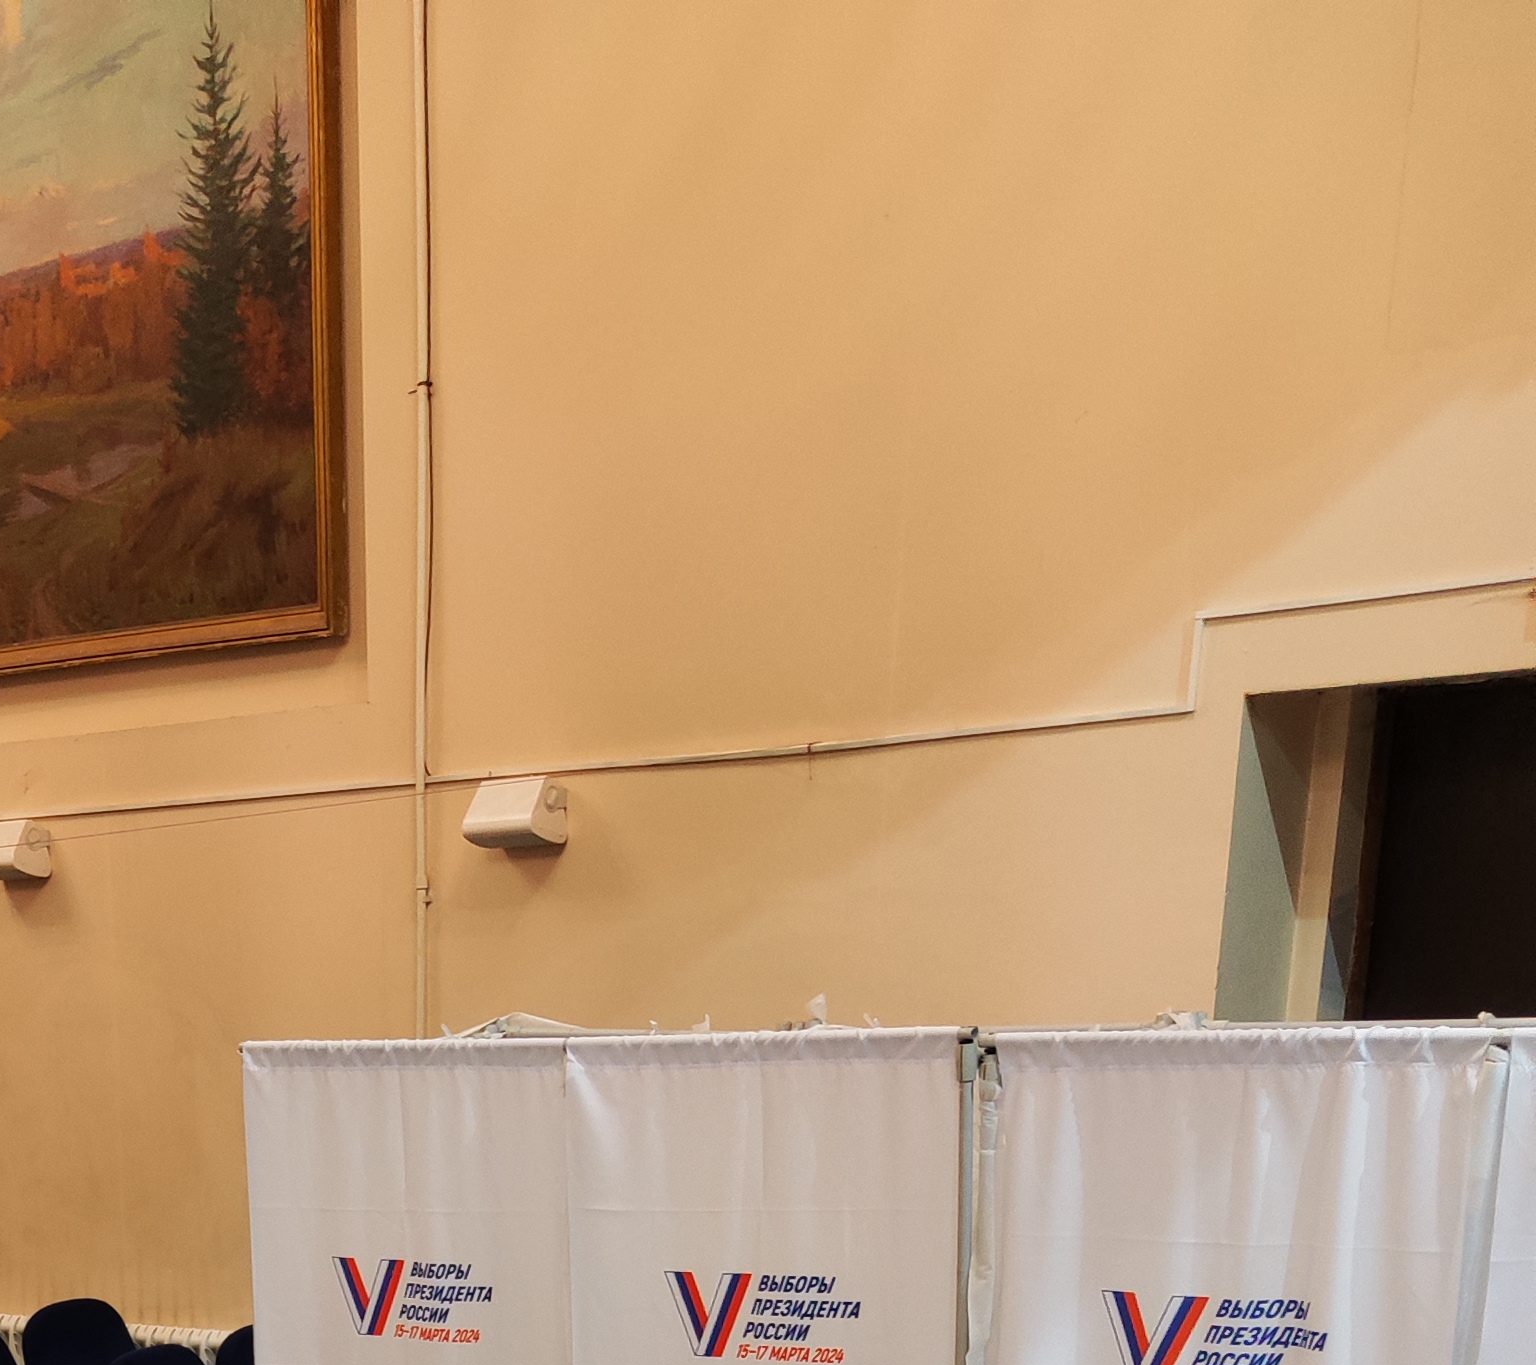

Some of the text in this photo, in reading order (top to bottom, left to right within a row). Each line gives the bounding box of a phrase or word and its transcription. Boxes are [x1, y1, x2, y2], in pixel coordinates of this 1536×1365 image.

[410, 1261, 472, 1280] ВЫБОРЫ
[403, 1282, 493, 1304] ПРЕЗИДЕНТА
[758, 1274, 836, 1294] ВЫБОРЫ
[398, 1303, 450, 1323] РОССИИ
[750, 1298, 861, 1320] ПРЕЗИДЕНТА
[1216, 1299, 1311, 1321] ВЫБОРЫ
[419, 1326, 450, 1343] МАРТА
[452, 1329, 481, 1344] 2024
[742, 1321, 811, 1341] РОССИИ
[1204, 1324, 1328, 1352] ПРЕЗИДЕНТА
[769, 1346, 809, 1363] МАРТА
[811, 1348, 845, 1364] 2024
